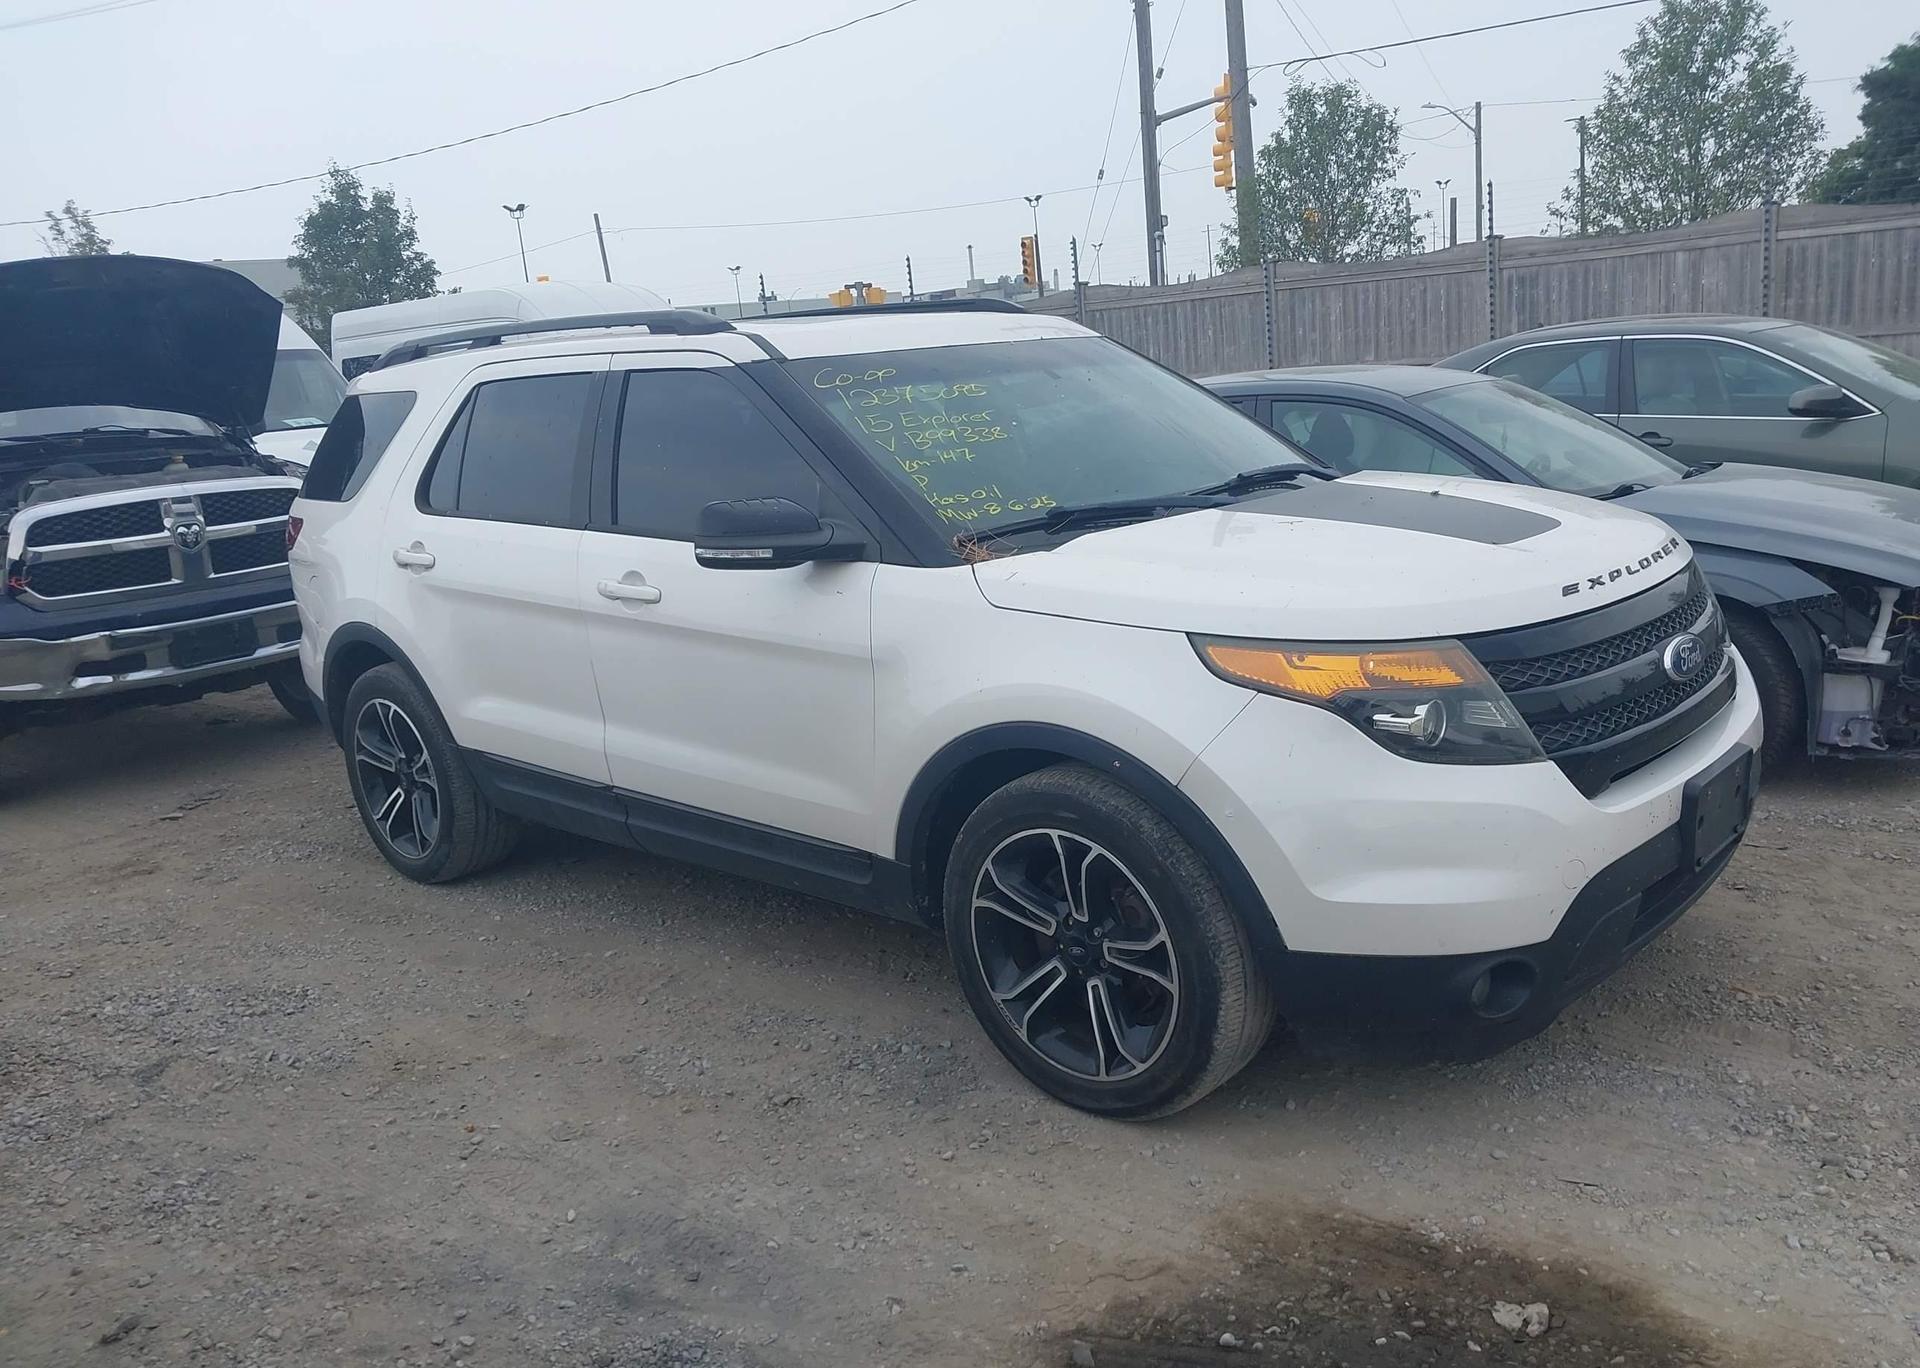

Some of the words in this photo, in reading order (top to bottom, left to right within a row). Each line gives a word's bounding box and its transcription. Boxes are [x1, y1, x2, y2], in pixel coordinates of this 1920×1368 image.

[854, 414, 894, 435] 15
[900, 410, 995, 430] Explorer
[1562, 537, 1679, 597] EXPLORER
[1680, 641, 1702, 672] Ford
